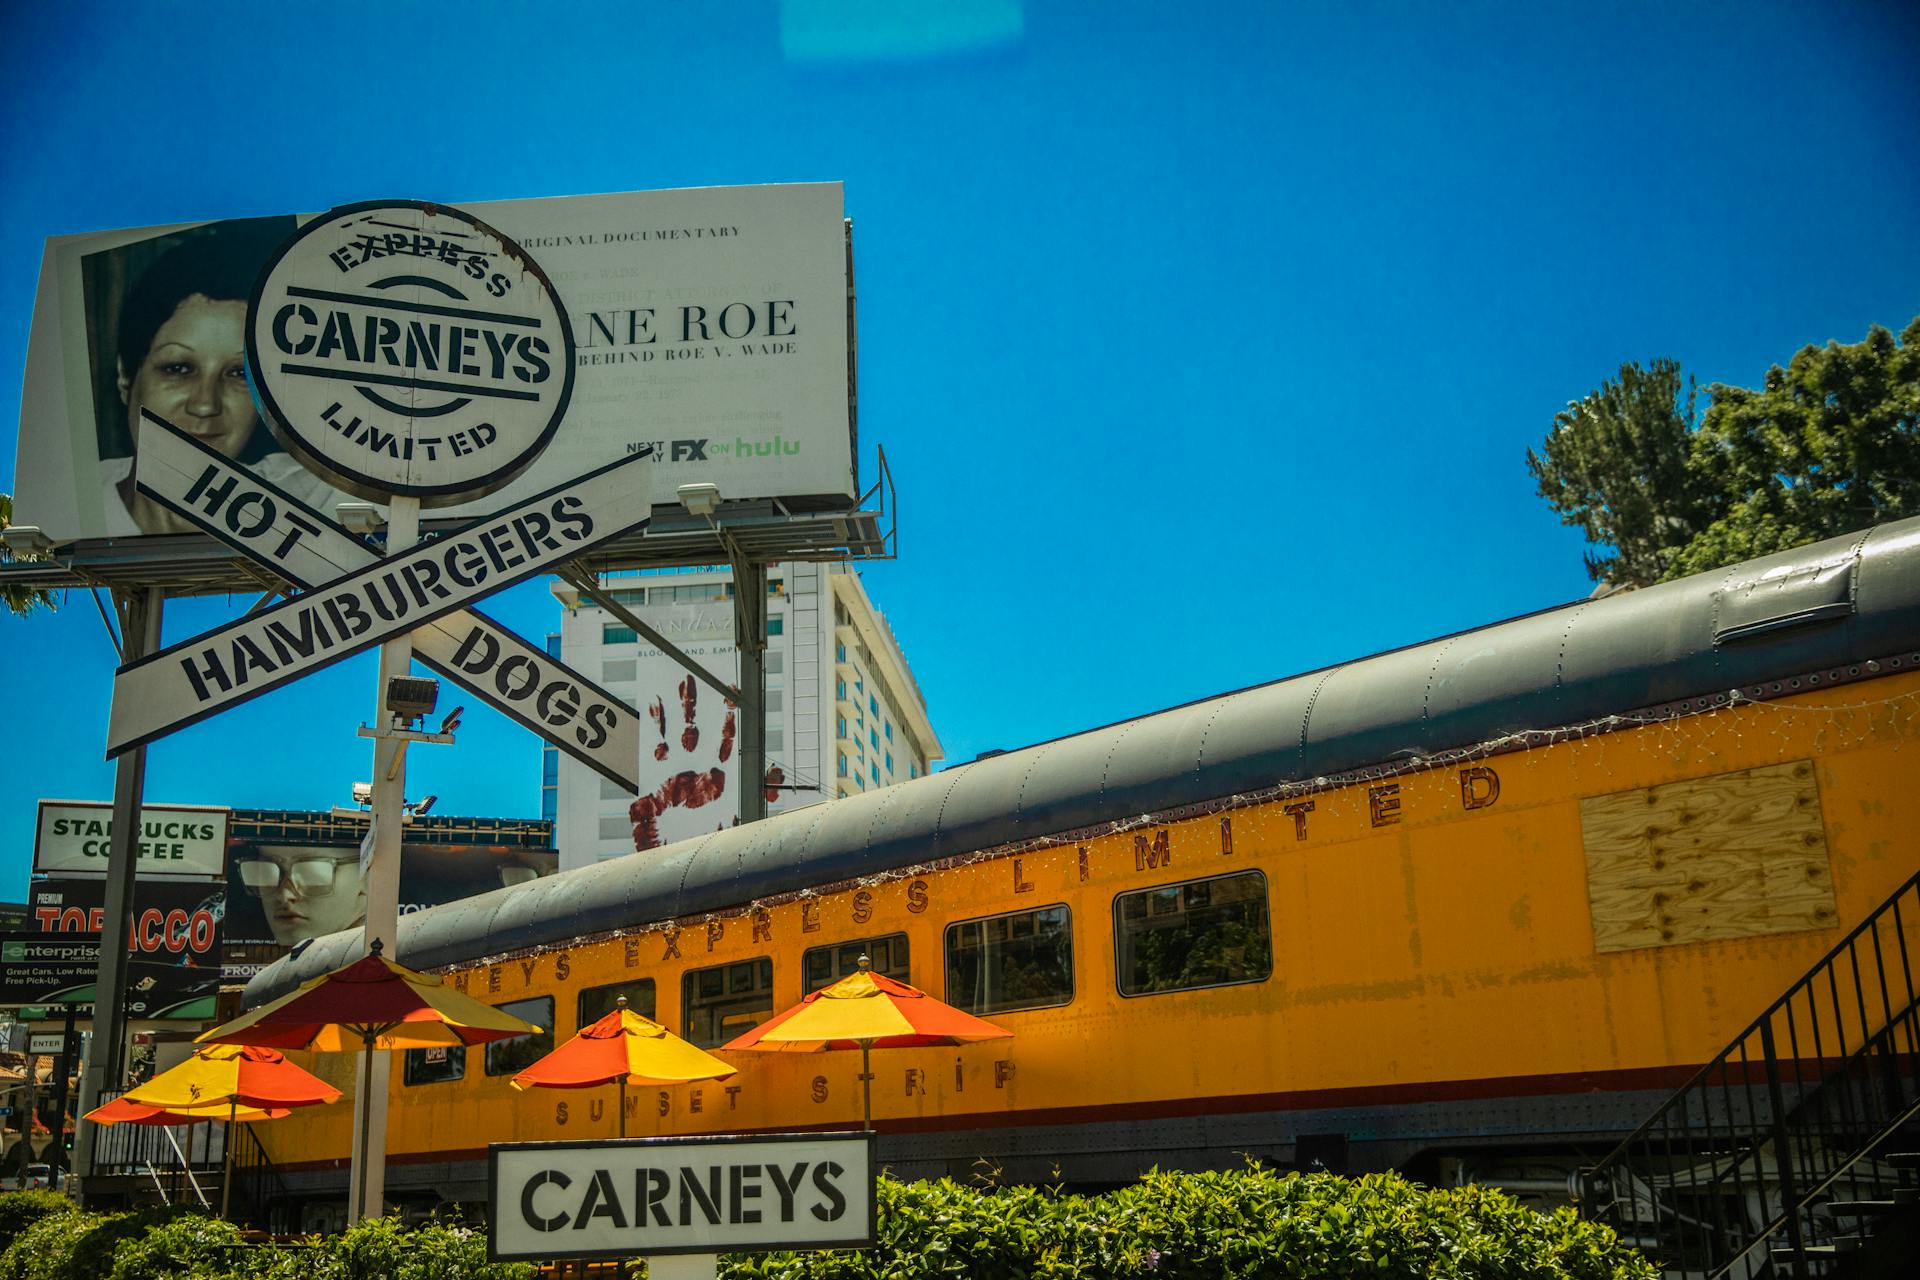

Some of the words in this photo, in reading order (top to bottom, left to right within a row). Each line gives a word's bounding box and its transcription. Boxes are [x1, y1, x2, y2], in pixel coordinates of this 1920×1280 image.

[604, 226, 742, 244] DOCUMENTARY
[575, 308, 657, 348] NE
[677, 300, 797, 342] ROE
[272, 303, 552, 385] CARNEYS
[579, 351, 654, 367] BEHIND
[665, 347, 704, 362] ROE
[742, 341, 797, 357] WADE
[320, 401, 498, 462] LIMITED
[671, 439, 709, 462] FX
[710, 443, 729, 454] ON
[735, 435, 800, 458] hulu
[180, 495, 595, 702] HAMBURGERS
[183, 463, 322, 561] HOT
[450, 626, 617, 751] DOGS
[636, 649, 665, 658] BLOO
[684, 647, 704, 656] AND
[712, 645, 737, 655] EMP
[53, 818, 214, 841] STAUCKS
[82, 840, 185, 860] CFEE
[454, 953, 571, 994] NEYS
[624, 879, 930, 969] EXPRESS
[1014, 766, 1501, 894] LIMITED
[37, 892, 63, 904] PREMIUM
[35, 905, 216, 953] TOCCO
[5, 977, 24, 985] Free
[26, 976, 61, 985] Pick-Up.
[6, 967, 30, 976] Great
[31, 967, 53, 976] Cars.
[56, 967, 74, 976] Low
[224, 965, 264, 976] FRON
[33, 1040, 60, 1048] ENTER
[427, 1047, 447, 1061] OPEN
[555, 1085, 741, 1126] SUNSET
[520, 1160, 847, 1233] CARNEYS
